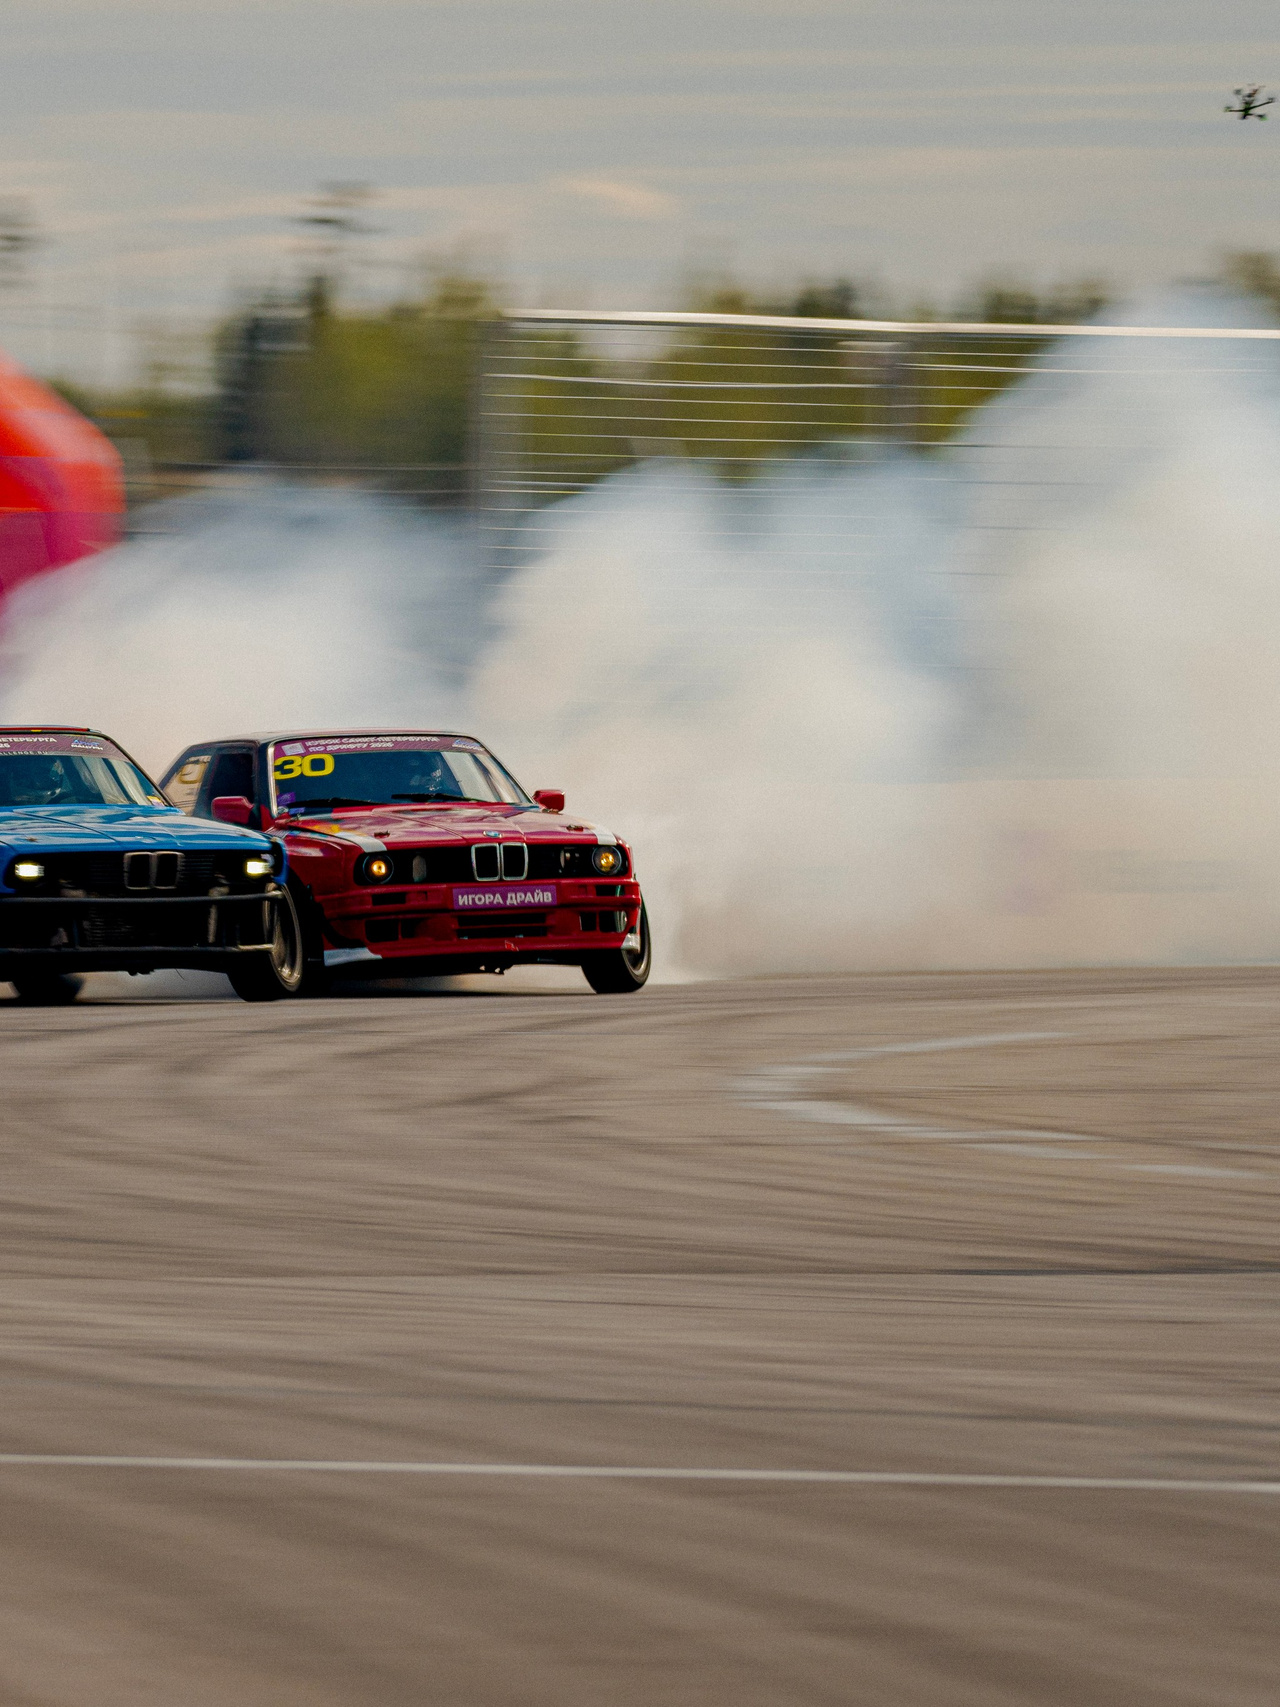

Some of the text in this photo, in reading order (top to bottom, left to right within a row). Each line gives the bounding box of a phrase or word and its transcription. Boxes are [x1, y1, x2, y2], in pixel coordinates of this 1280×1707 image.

[273, 753, 335, 780] 30
[458, 889, 552, 906] ИГОРА ДРАЙВ
